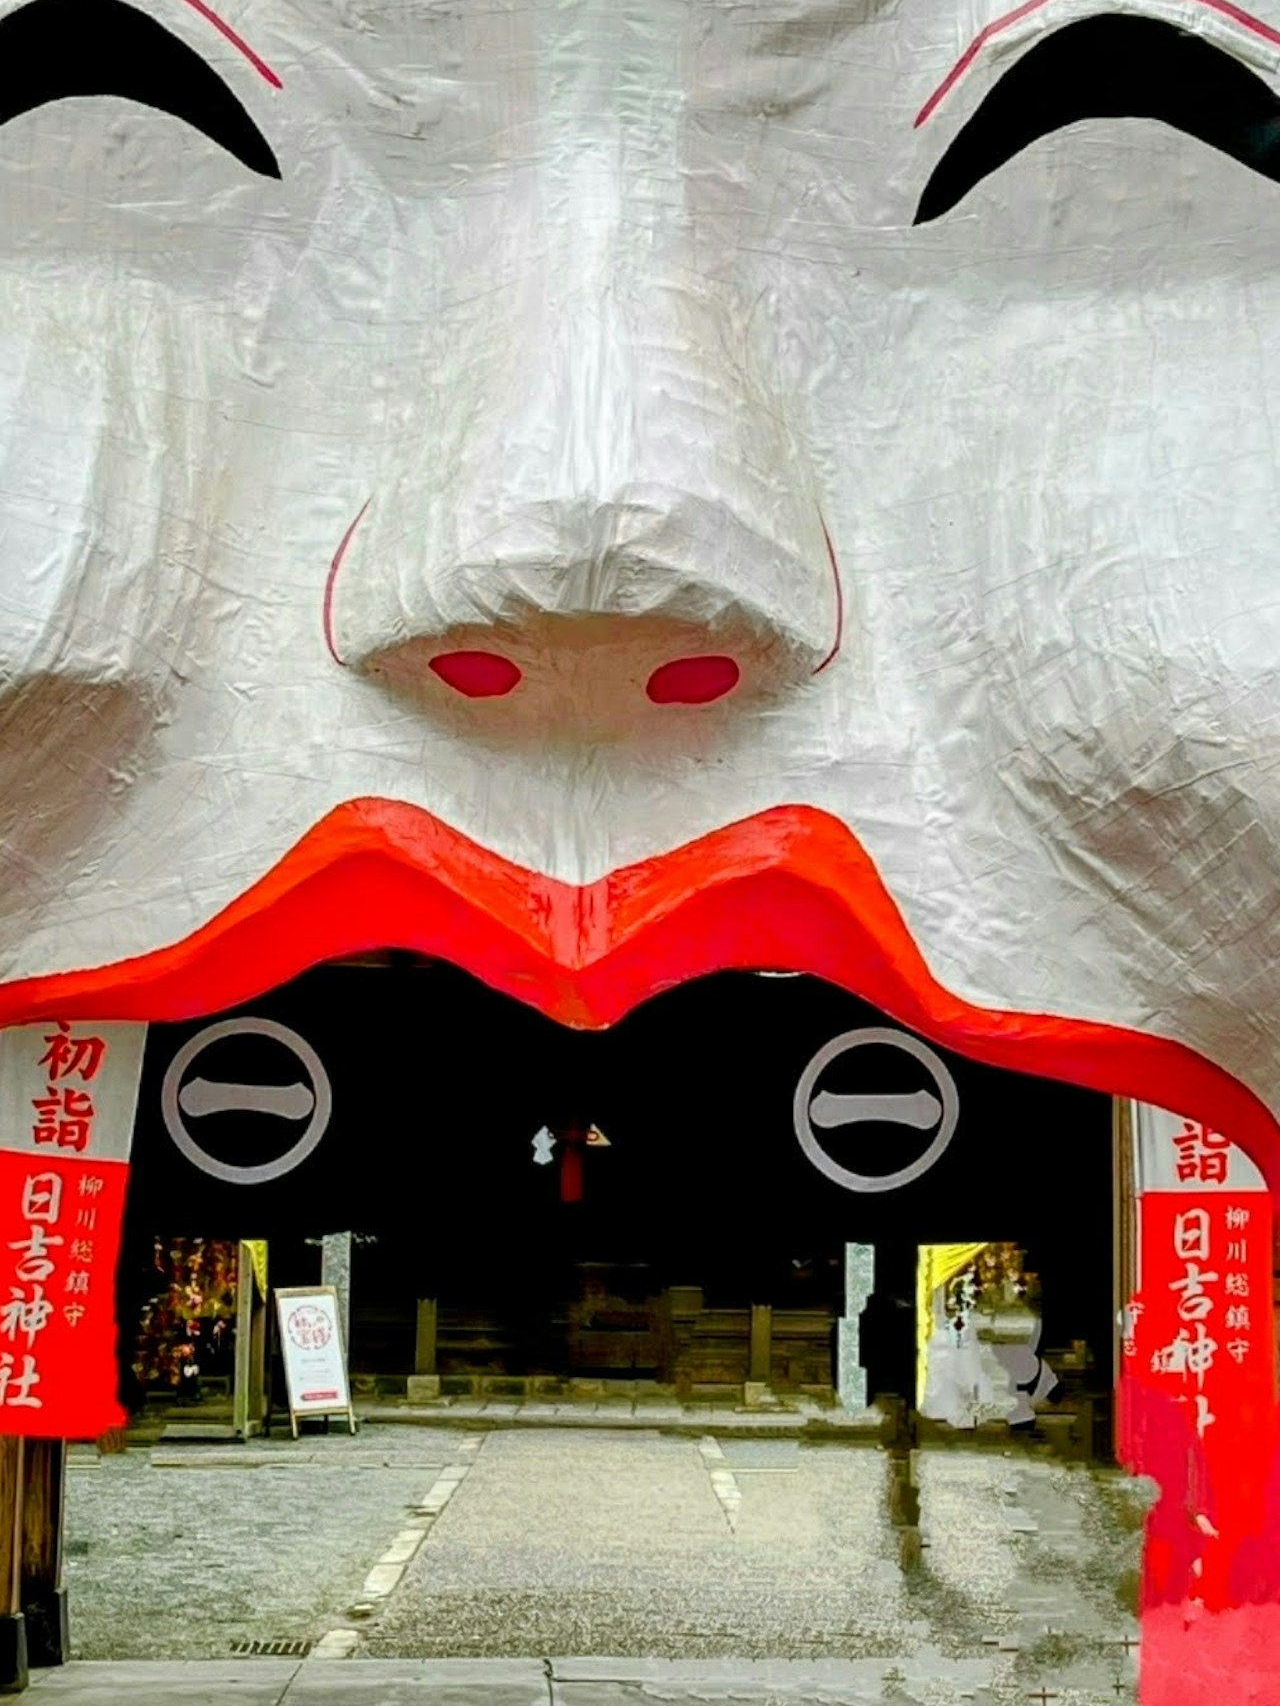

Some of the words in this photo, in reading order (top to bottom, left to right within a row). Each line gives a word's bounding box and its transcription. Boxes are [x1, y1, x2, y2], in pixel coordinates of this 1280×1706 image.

[32, 1020, 106, 1153] 初詣
[63, 1172, 104, 1329] 柳川総鎮守
[1224, 1203, 1251, 1364] 柳川総鎮守
